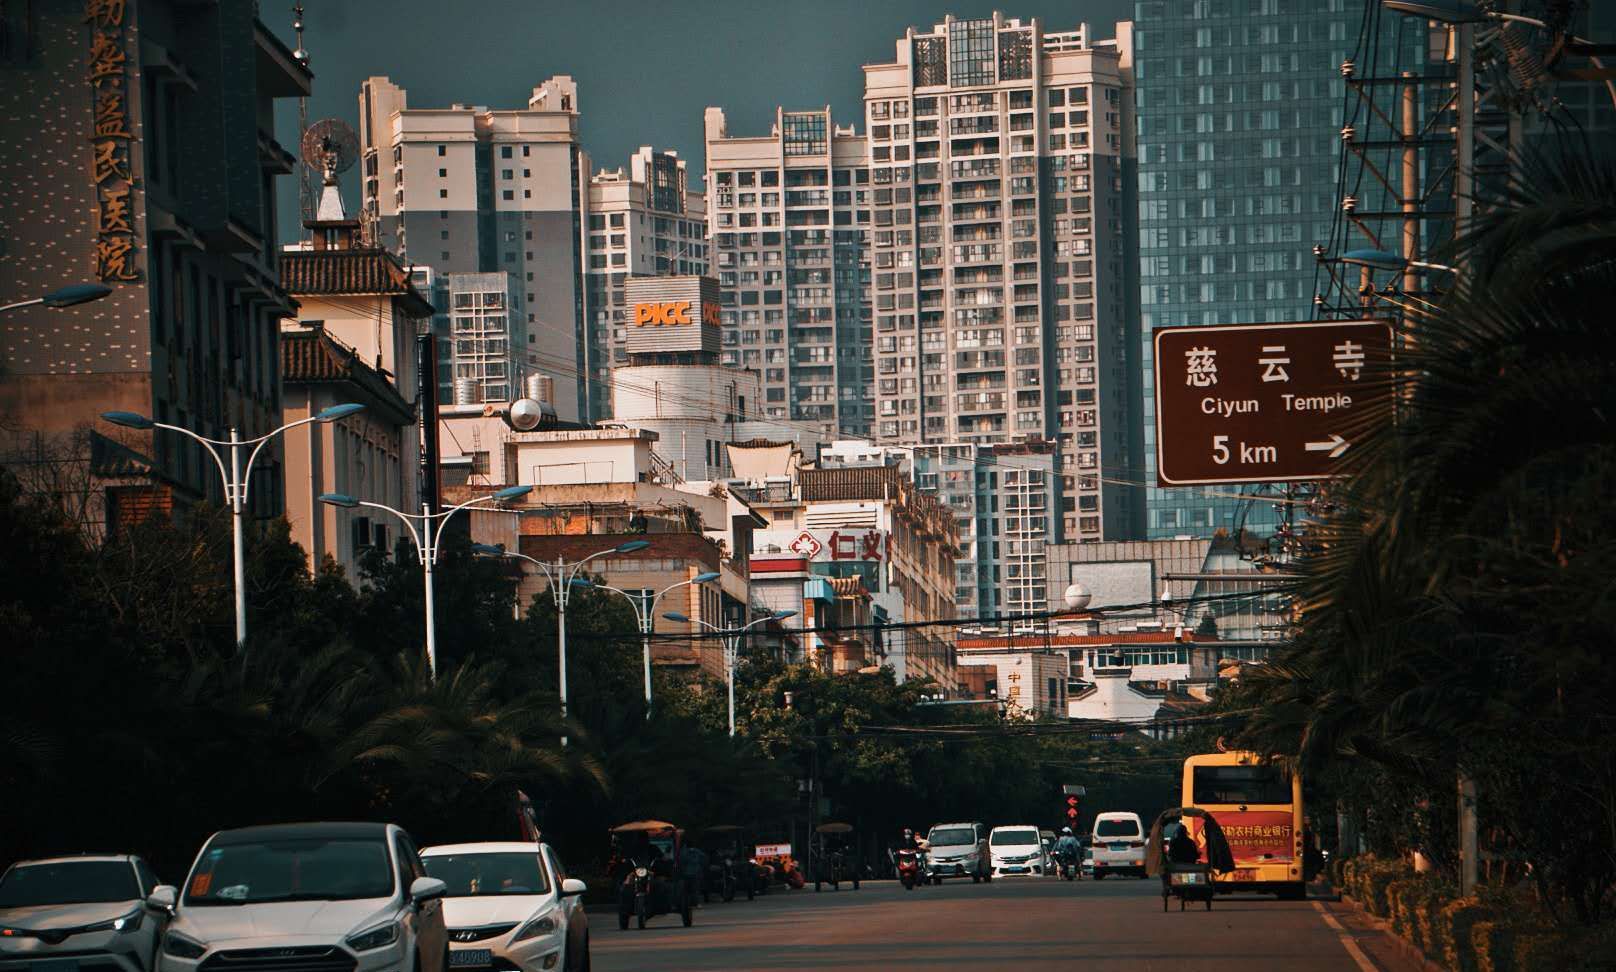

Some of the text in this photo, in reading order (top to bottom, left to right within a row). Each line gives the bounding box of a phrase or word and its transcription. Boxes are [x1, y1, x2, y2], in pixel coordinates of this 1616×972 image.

[634, 302, 691, 326] PICC
[1185, 341, 1365, 387] 慈云寺
[1201, 392, 1352, 418] Ciyun Temple
[1212, 435, 1277, 465] 5 km
[828, 530, 893, 560] 仁义
